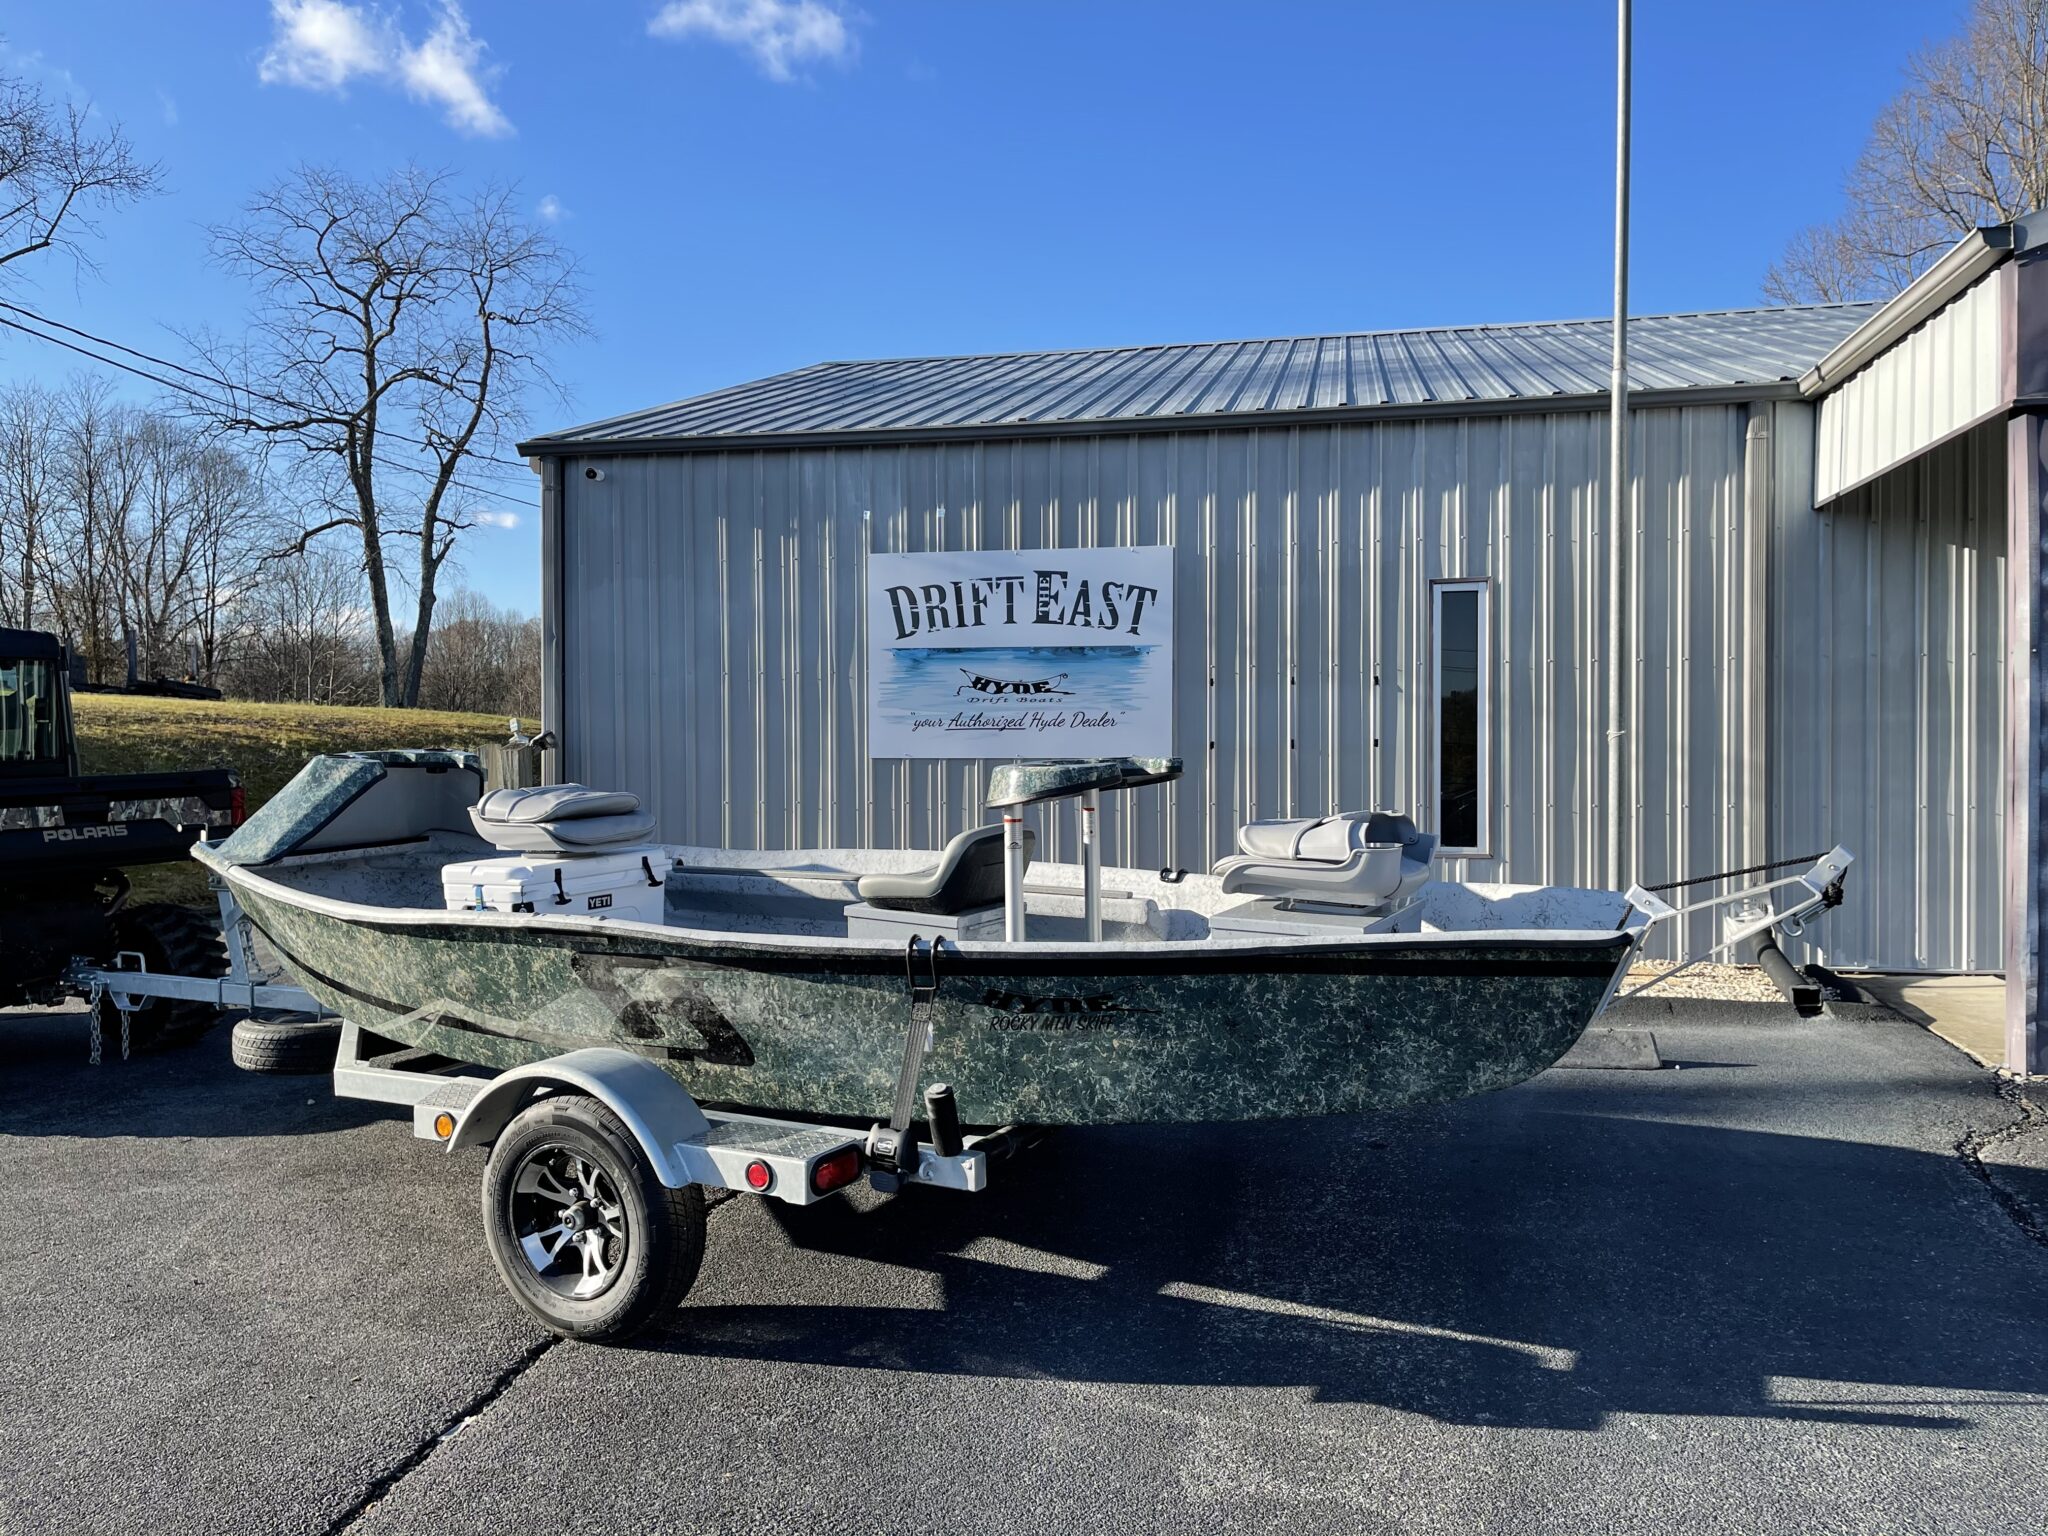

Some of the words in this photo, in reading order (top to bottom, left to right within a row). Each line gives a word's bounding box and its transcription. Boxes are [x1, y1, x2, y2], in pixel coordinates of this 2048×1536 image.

[1032, 570, 1158, 636] EAST
[1038, 577, 1051, 616] THE
[883, 575, 1025, 640] DRIFT
[972, 675, 1052, 695] HYDE
[966, 696, 1009, 704] Drift
[946, 711, 1029, 731] Authorized
[1029, 711, 1066, 731] Hyde
[43, 824, 128, 842] POLARIS
[589, 896, 611, 908] YETI
[989, 1015, 1039, 1031] ROCKY
[1041, 1015, 1074, 1031] MTN
[1077, 1014, 1115, 1030] SKIFF
